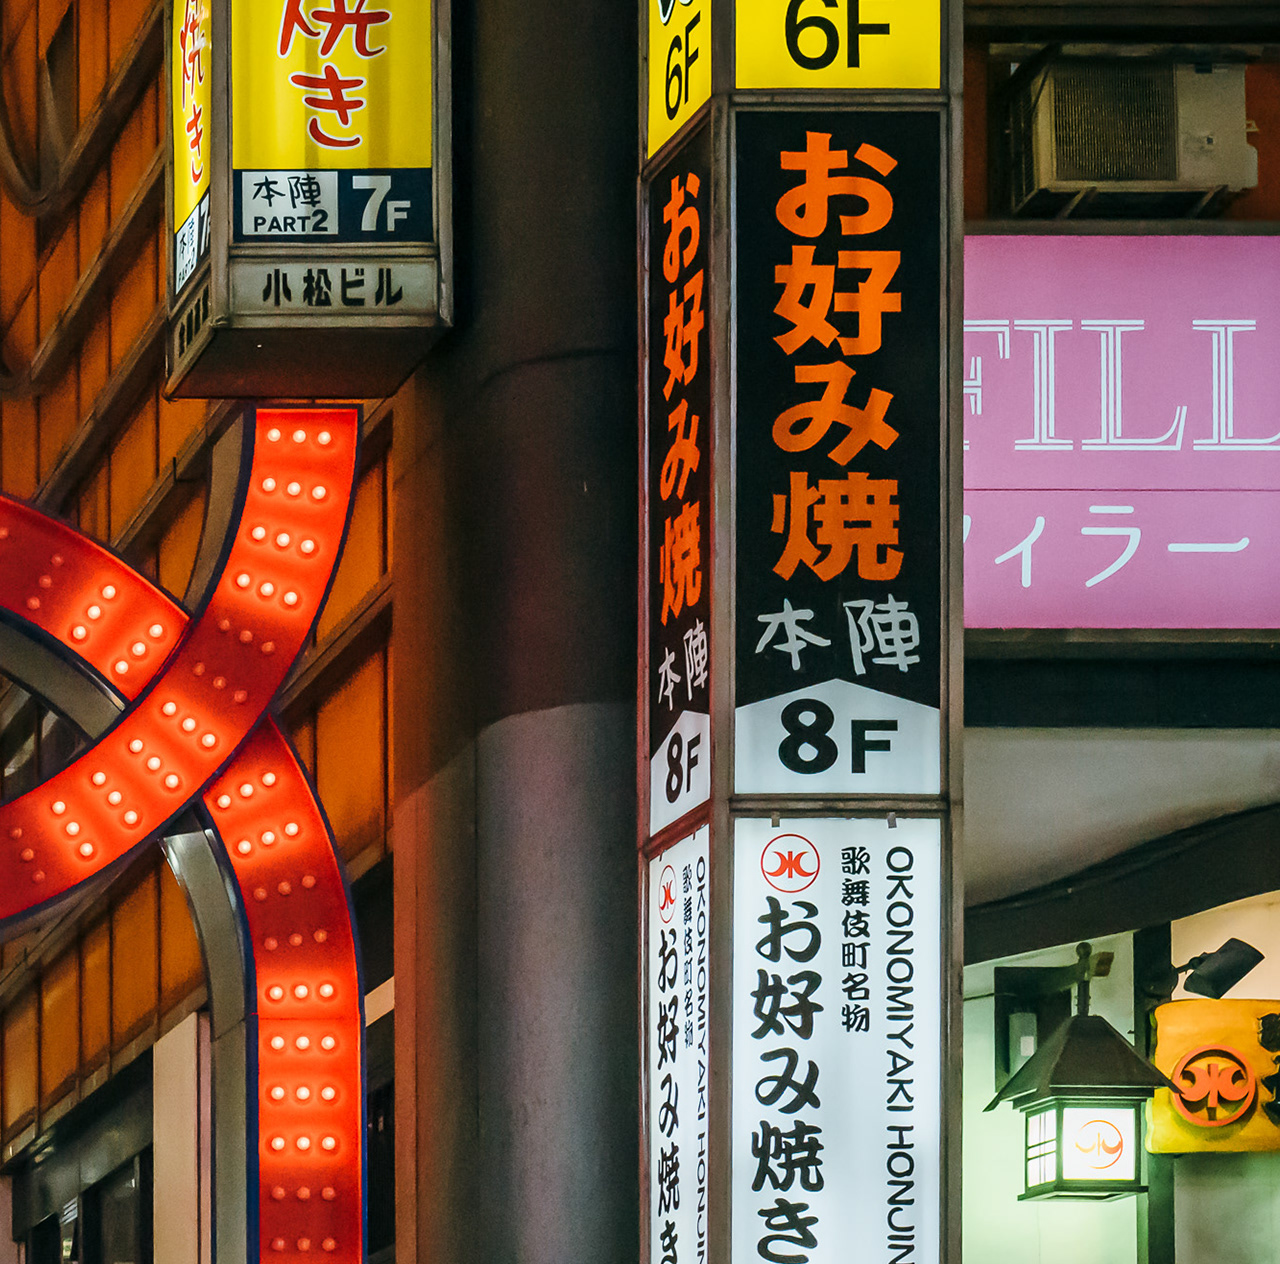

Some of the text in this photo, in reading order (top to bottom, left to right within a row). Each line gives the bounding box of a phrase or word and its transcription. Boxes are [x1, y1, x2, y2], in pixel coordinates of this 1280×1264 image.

[665, 11, 701, 121] 6F
[784, 0, 891, 70] 6F
[253, 174, 322, 209] 本陣
[253, 209, 329, 233] PART2
[352, 175, 412, 232] 7F
[262, 268, 404, 307] 小松ビル
[771, 130, 905, 582] お好み焼
[660, 169, 706, 627] お好み焼
[963, 504, 1251, 589] ィラー
[658, 618, 709, 712] 本陣
[756, 594, 922, 676] 本陣
[663, 730, 703, 803] 8F
[777, 698, 899, 776] 8F
[840, 845, 872, 1035] 歌舞伎町名物
[886, 845, 915, 1113] OKONOMIYAKI
[696, 854, 708, 1122] OKONOMIYAKI
